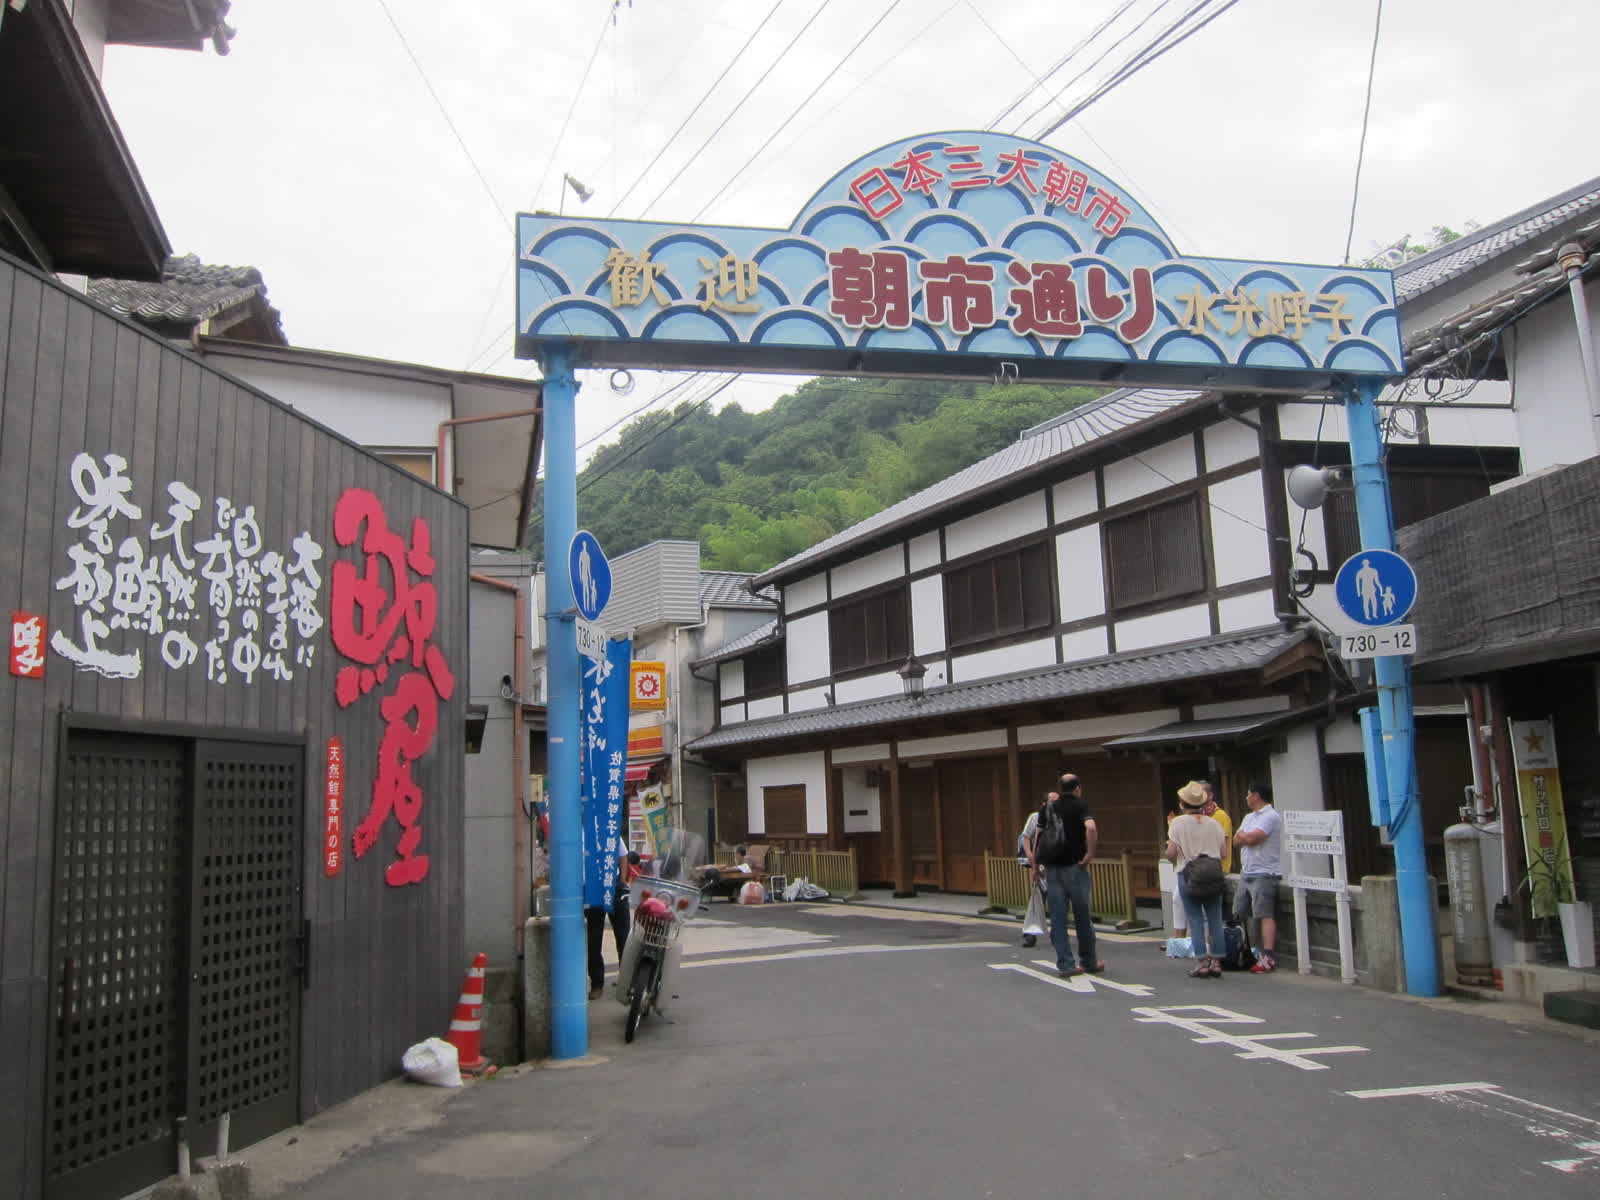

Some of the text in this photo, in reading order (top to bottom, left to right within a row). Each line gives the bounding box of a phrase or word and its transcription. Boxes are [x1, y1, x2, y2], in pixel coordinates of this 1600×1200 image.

[850, 145, 1131, 237] 日本三大朝市
[827, 246, 1155, 344] 朝市通り
[1175, 284, 1353, 342] 水光呼子
[232, 505, 262, 684] 自然の中
